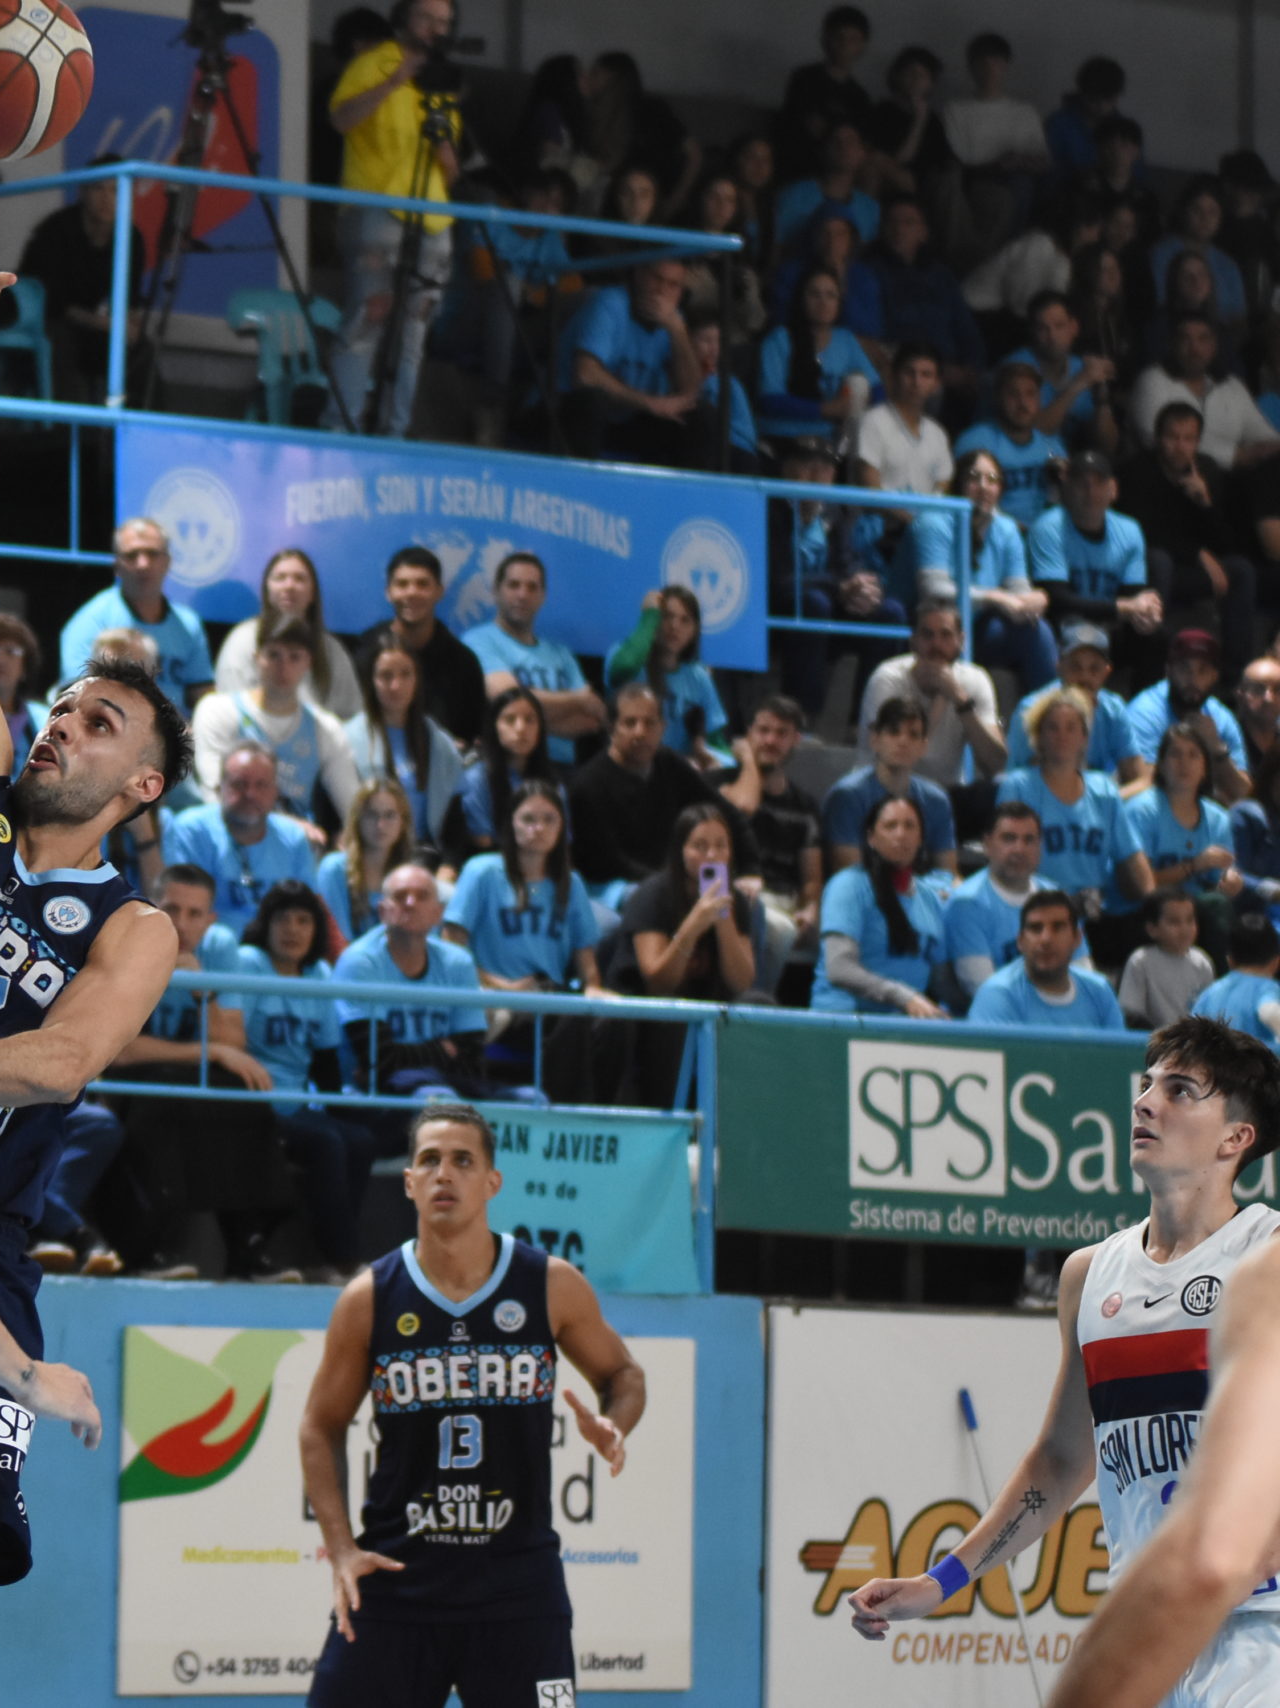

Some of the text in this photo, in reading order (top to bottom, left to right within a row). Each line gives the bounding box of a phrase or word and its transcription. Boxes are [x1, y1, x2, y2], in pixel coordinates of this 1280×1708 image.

[376, 475, 418, 515] SON
[422, 476, 436, 515] Y
[510, 487, 632, 560] ARGENTINAS
[858, 1066, 993, 1182] SPS
[543, 1131, 620, 1164] JAVIER
[525, 1180, 578, 1200] es de
[849, 1199, 942, 1232] Sistema
[948, 1205, 977, 1234] de
[983, 1209, 1109, 1240] Prevención
[387, 1353, 537, 1404] OBERA
[438, 1414, 483, 1470] 13
[1100, 1424, 1137, 1496] SAN
[438, 1485, 481, 1502] DON
[405, 1498, 513, 1536] BASILIO
[181, 1546, 300, 1565] Medicamentos
[561, 1547, 639, 1564] Accesorios
[206, 1657, 237, 1676] +54
[580, 1652, 645, 1671] Libertad
